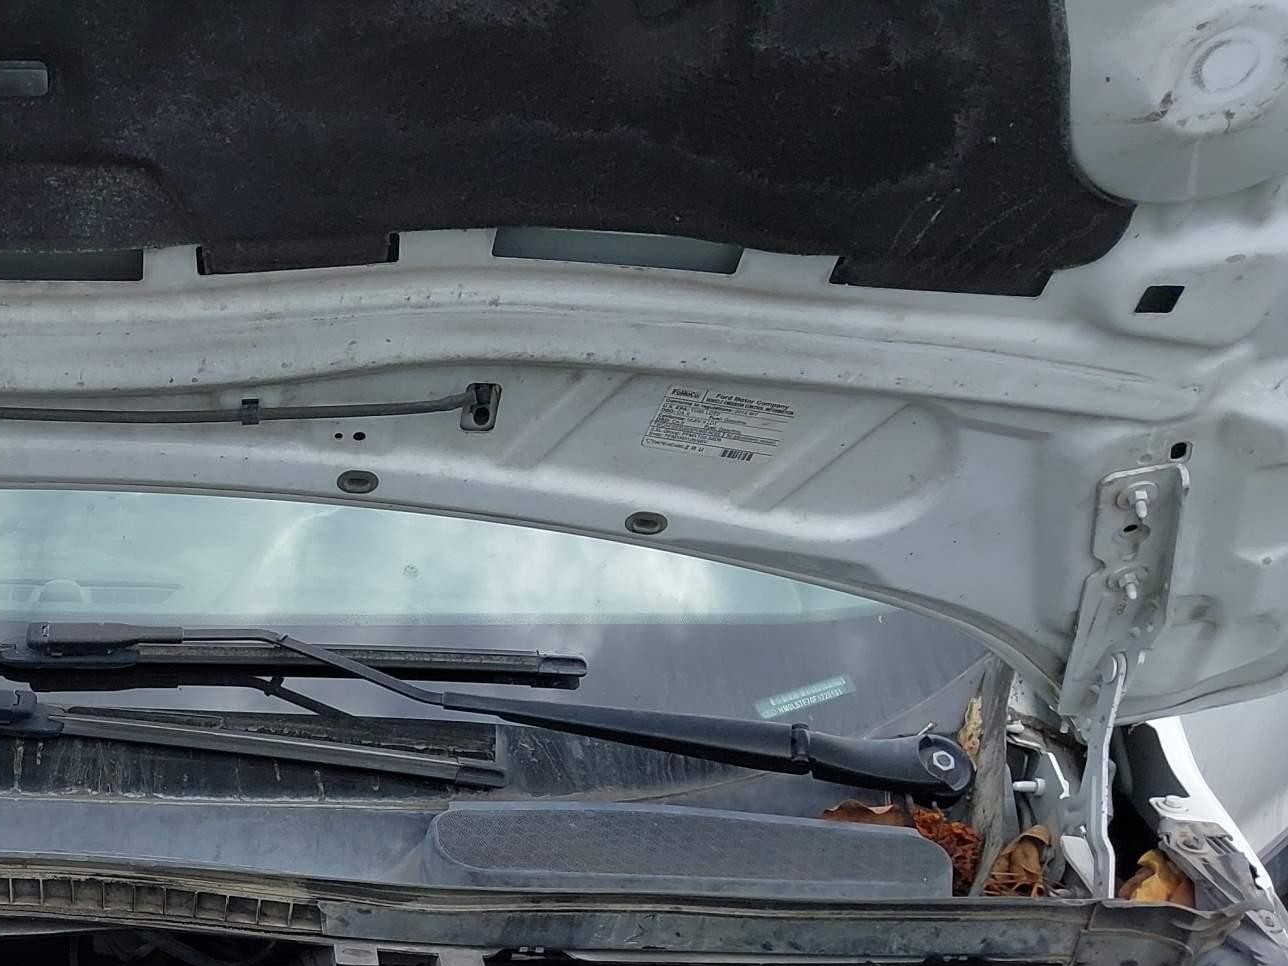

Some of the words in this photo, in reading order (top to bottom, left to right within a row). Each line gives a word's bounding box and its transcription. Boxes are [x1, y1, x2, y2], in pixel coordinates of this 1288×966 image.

[715, 393, 733, 401] Ford
[734, 396, 754, 404] Motor
[756, 400, 790, 411] Company
